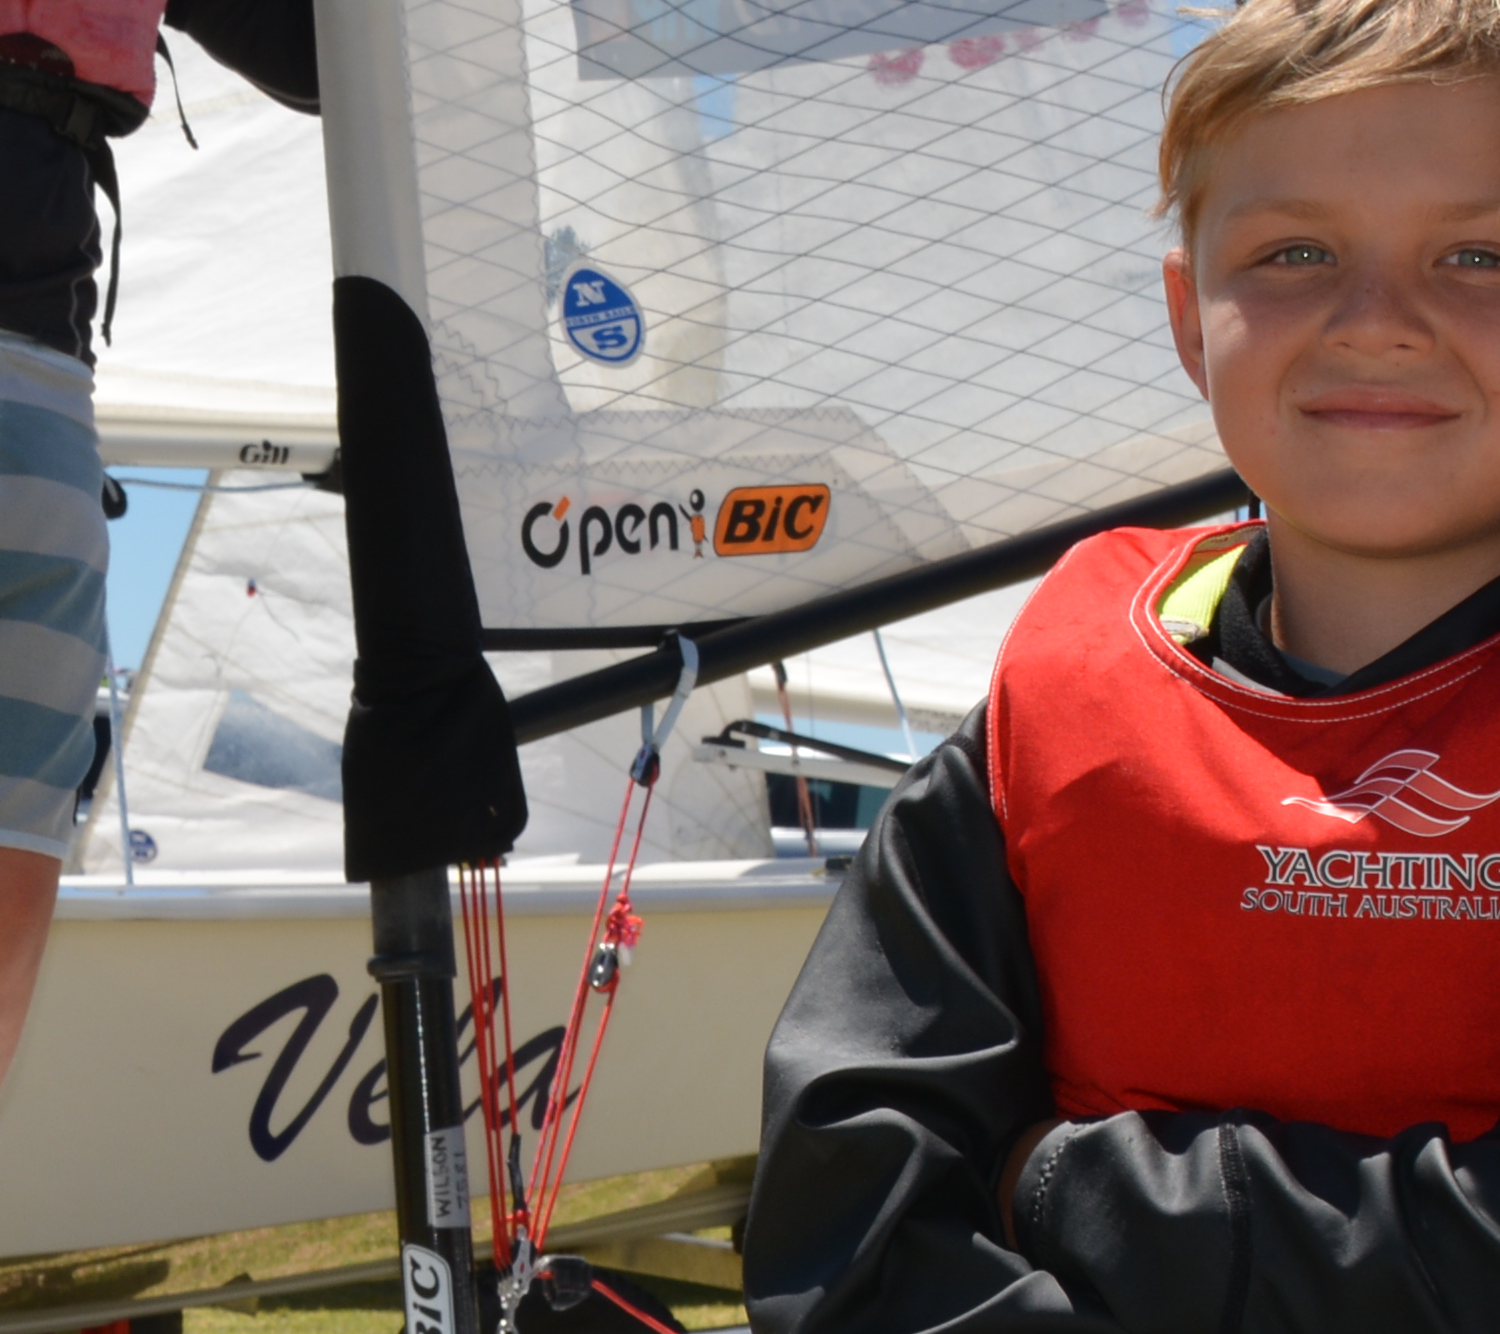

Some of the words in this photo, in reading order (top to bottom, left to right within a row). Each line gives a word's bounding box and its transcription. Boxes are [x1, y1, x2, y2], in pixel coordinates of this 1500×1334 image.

[572, 280, 607, 307] N
[591, 325, 628, 351] S
[239, 439, 290, 465] Gill
[1241, 887, 1347, 918] SOUTH
[427, 1135, 451, 1218] WILSON
